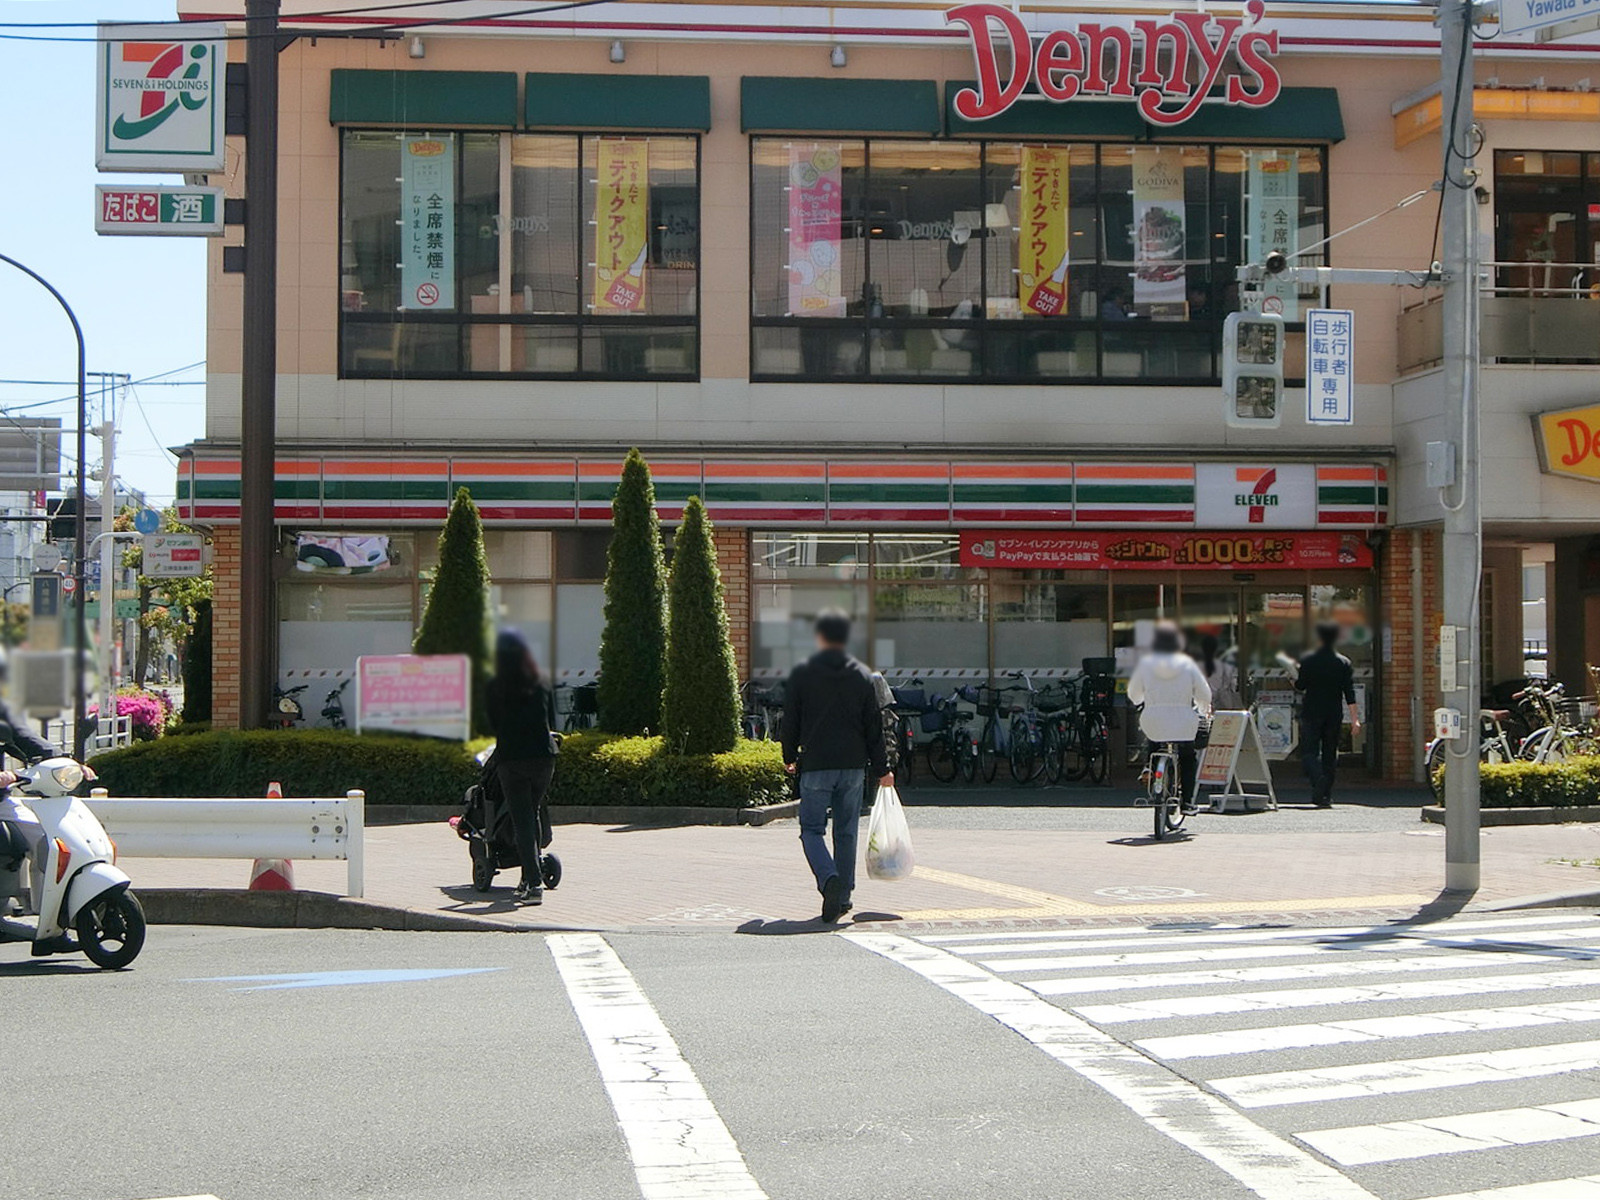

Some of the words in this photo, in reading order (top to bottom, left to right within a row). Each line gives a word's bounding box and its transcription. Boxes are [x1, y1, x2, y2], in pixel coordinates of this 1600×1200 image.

[943, 1, 1282, 126] Denny's
[159, 79, 209, 91] HOLDINGS
[1137, 177, 1179, 187] GODIVA
[105, 193, 156, 221] たばこ
[171, 194, 204, 222] 酒
[608, 160, 627, 270] テイクアウト
[1031, 167, 1049, 277] テイクアウト
[426, 193, 444, 280] 全席禁煙に
[612, 293, 631, 307] OUT
[615, 285, 637, 300] TAKE
[1035, 299, 1055, 313] OUT
[1038, 290, 1059, 305] TAKE
[1313, 319, 1329, 374] 自転車
[1332, 320, 1347, 376] 歩行者
[1322, 378, 1338, 415] 専用
